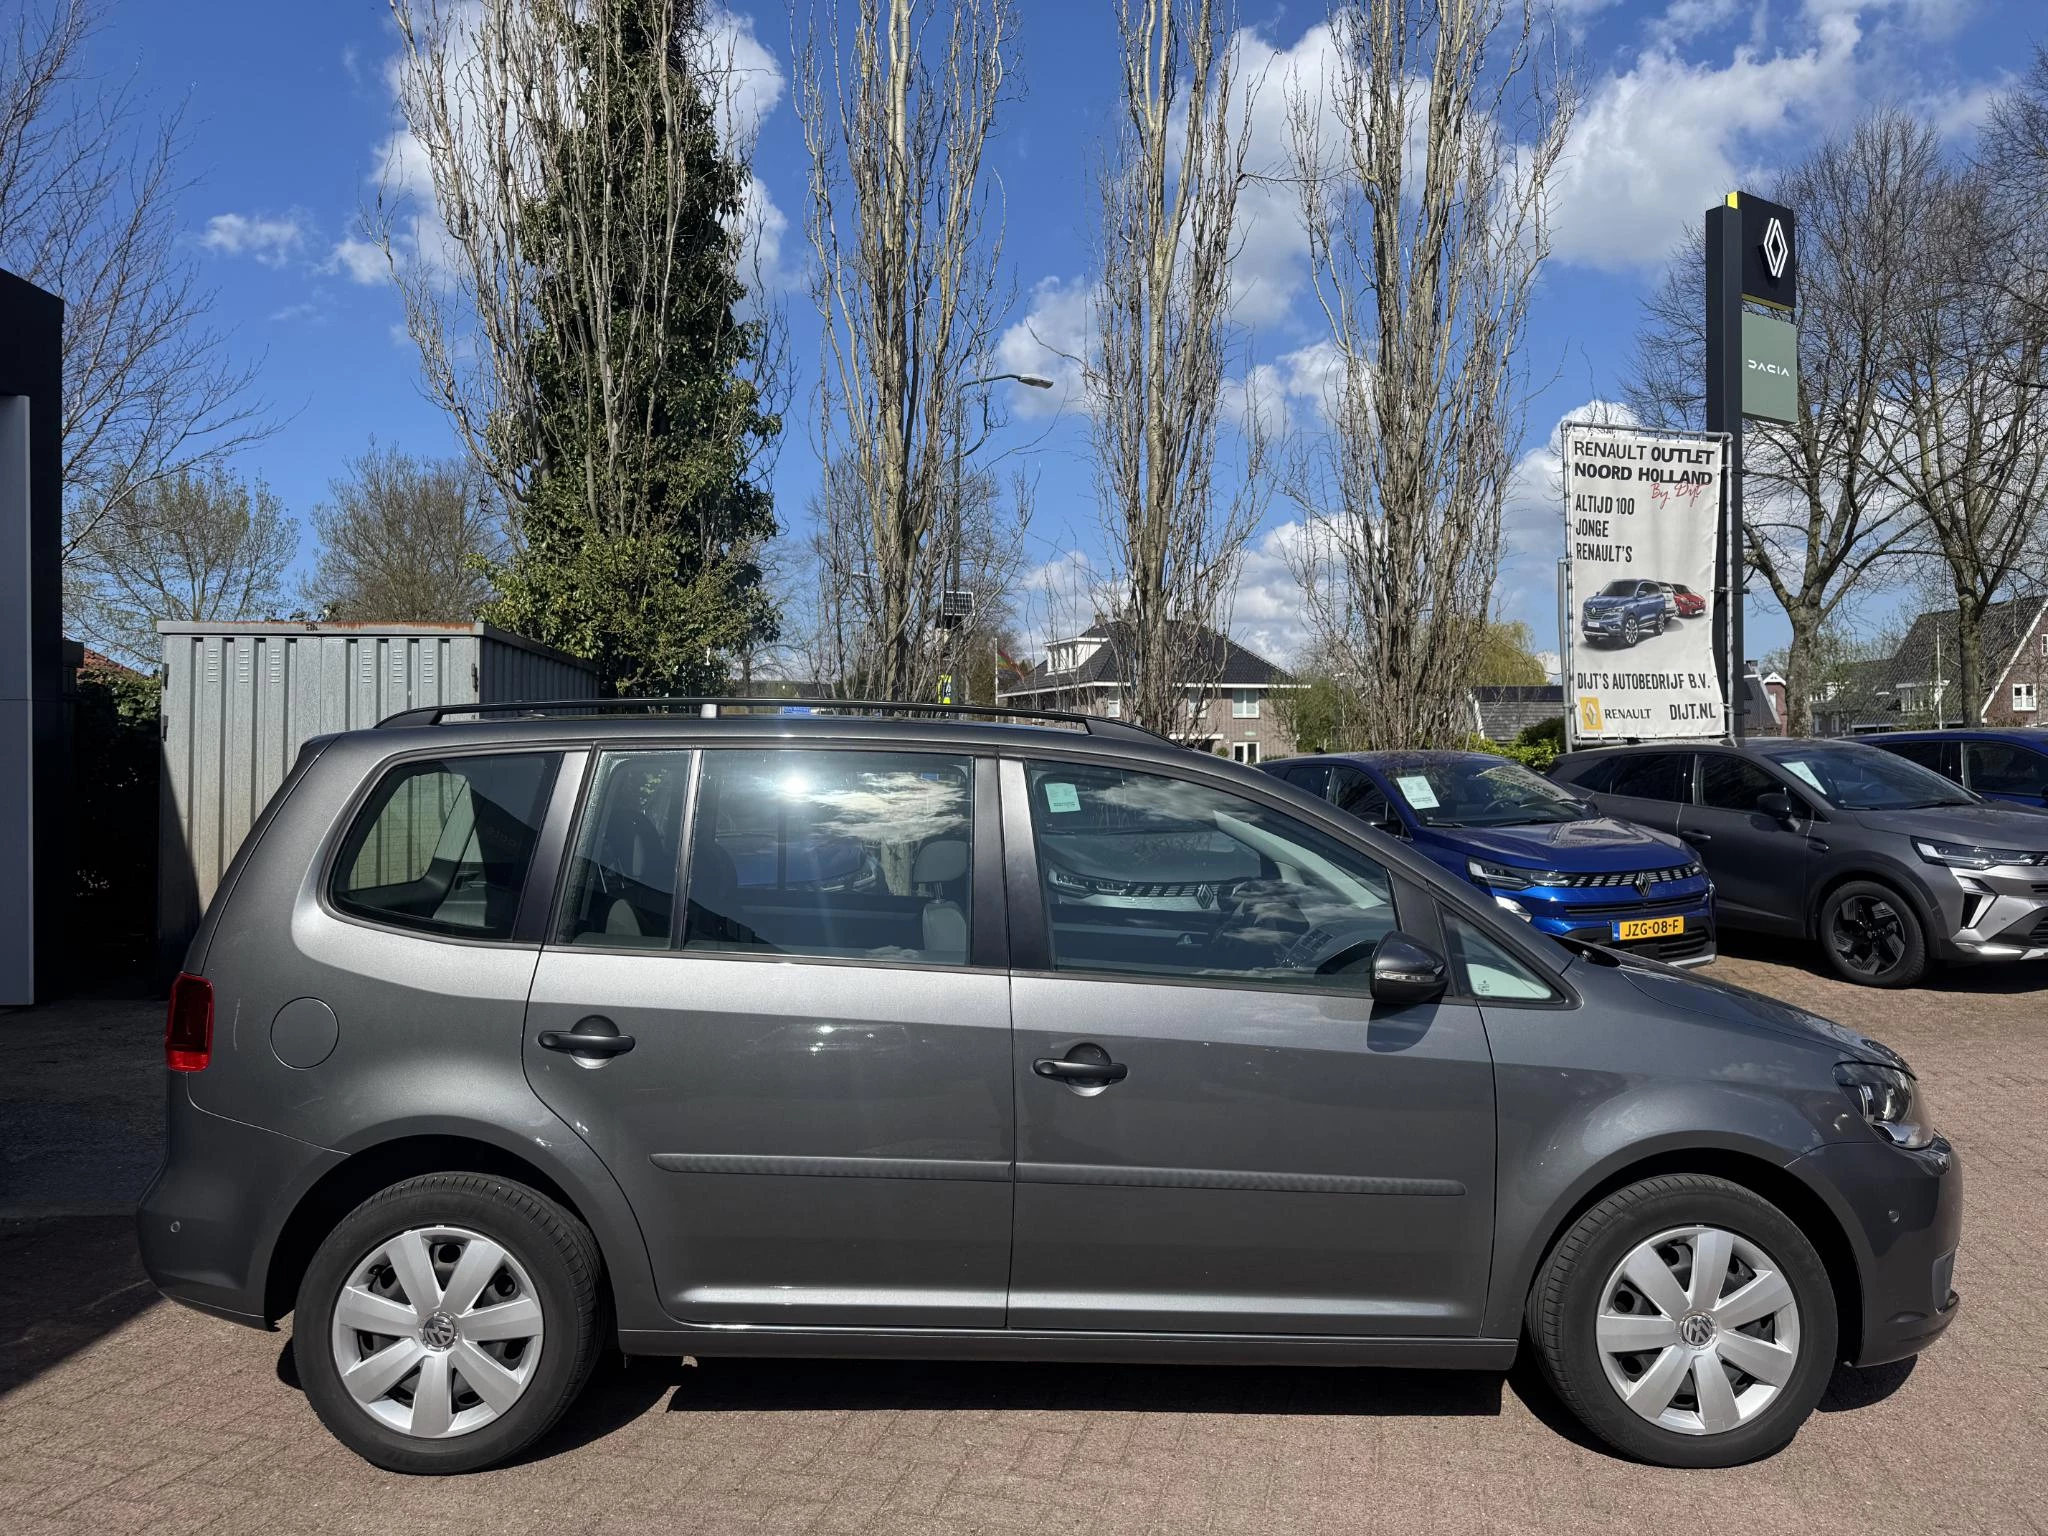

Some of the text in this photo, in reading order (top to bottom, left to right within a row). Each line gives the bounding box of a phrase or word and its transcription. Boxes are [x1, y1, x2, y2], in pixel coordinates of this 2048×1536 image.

[1747, 359, 1790, 377] DACIA
[1574, 441, 1715, 465] RENAULT OUTLET
[1574, 462, 1713, 485] NOORD HOLLAND
[1575, 494, 1635, 515] ALTIJD 100
[1650, 482, 1670, 509] By
[1575, 518, 1609, 538] JONGE
[1576, 542, 1633, 563] RENAULT'S
[1577, 672, 1711, 690] DIJT'S AUTOBEDRIJF B.V.
[1604, 708, 1652, 720] RENAULT
[1669, 702, 1717, 720] DIJT.NL
[1625, 919, 1679, 937] JZG-08-F
